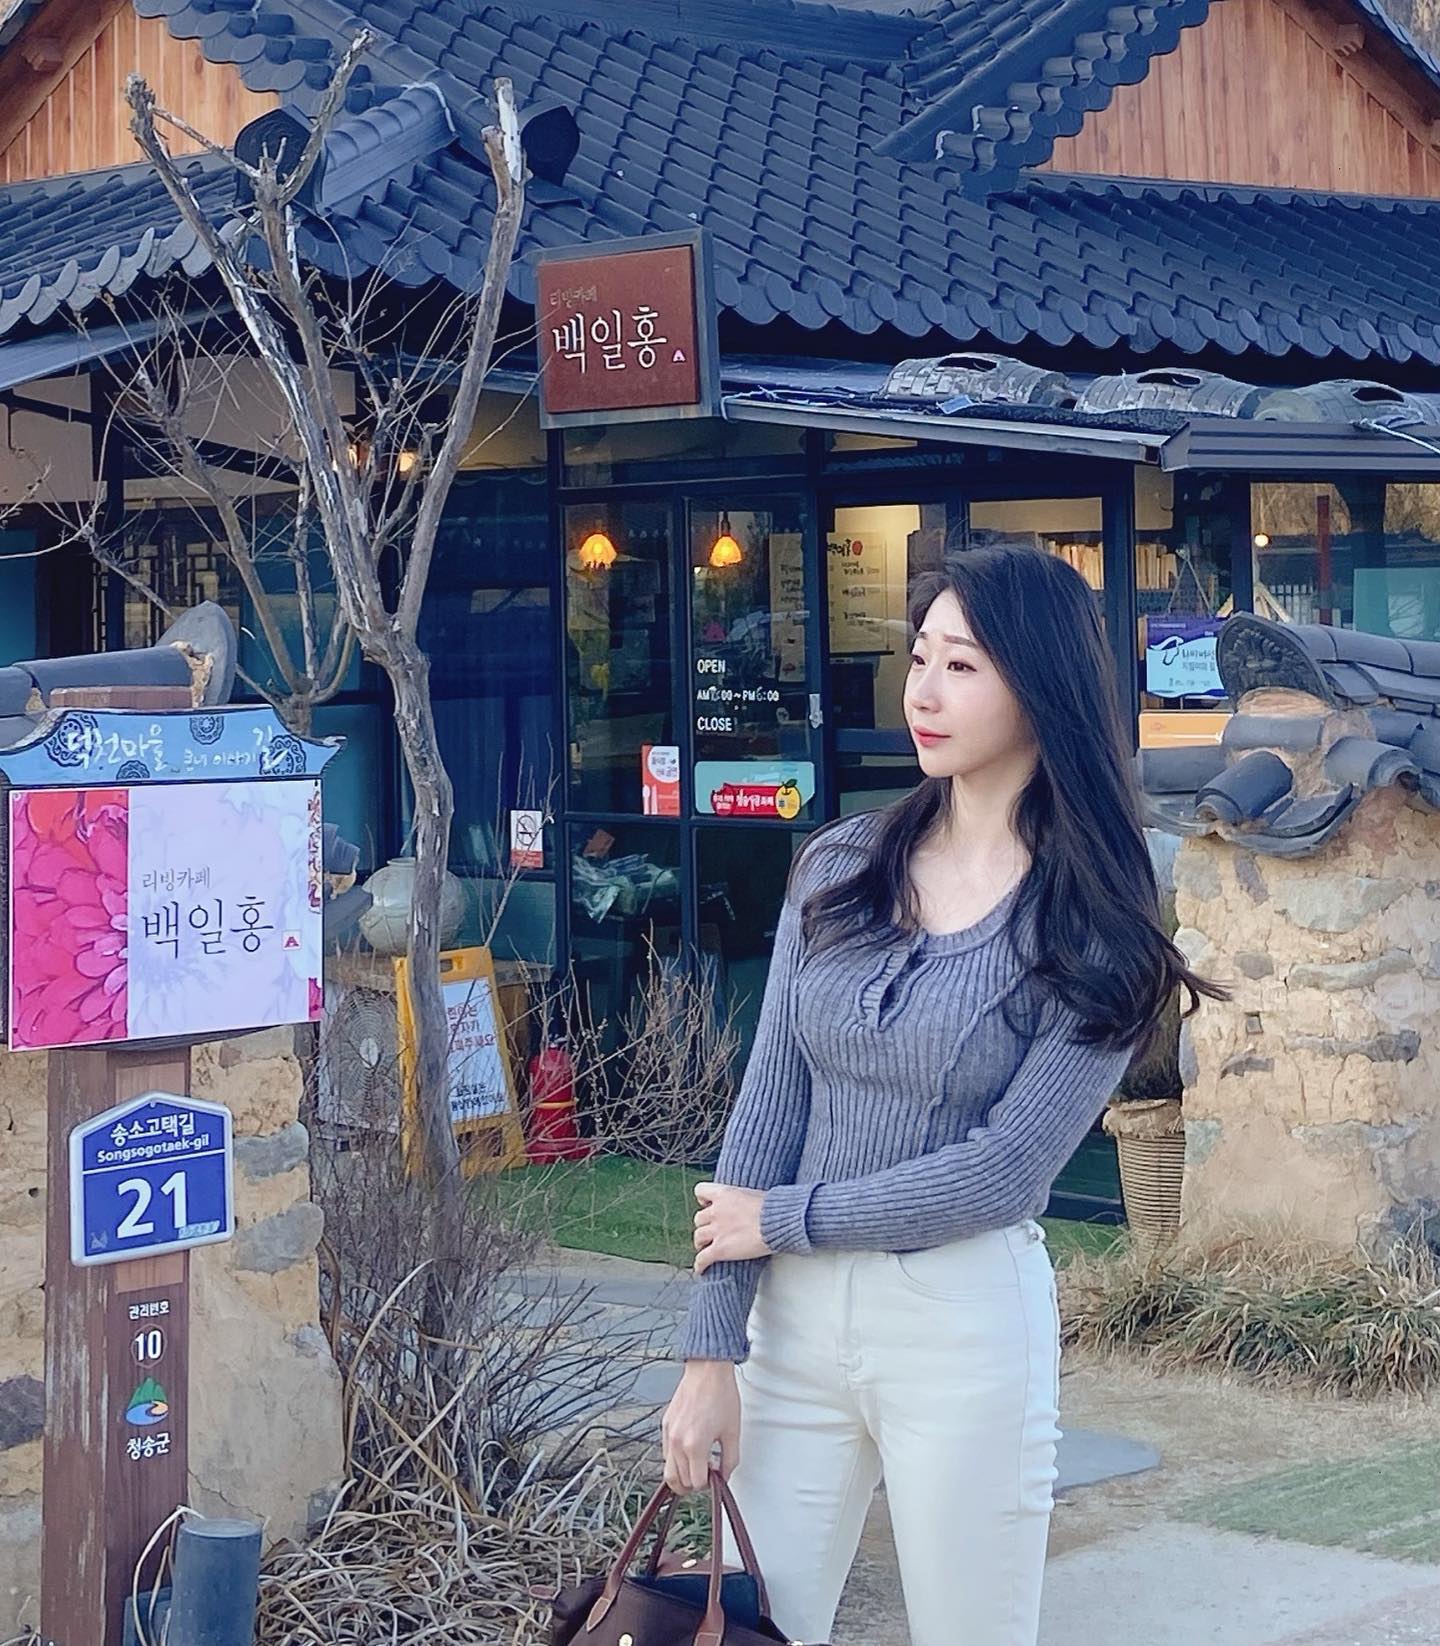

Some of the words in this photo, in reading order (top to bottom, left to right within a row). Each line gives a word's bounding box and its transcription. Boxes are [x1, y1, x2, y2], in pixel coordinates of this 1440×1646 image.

[552, 306, 667, 374] 백일홍
[696, 659, 726, 674] OPEN
[696, 716, 733, 731] CLOSE
[142, 867, 211, 891] 리빙카페
[141, 896, 274, 959] 백일홍
[110, 1112, 195, 1147] 송소고택길
[97, 1134, 209, 1163] Songsogotaek-gil
[116, 1171, 188, 1239] 21
[128, 1301, 169, 1320] 관리번호
[135, 1330, 162, 1361] 10
[127, 1433, 170, 1460] 청송군
